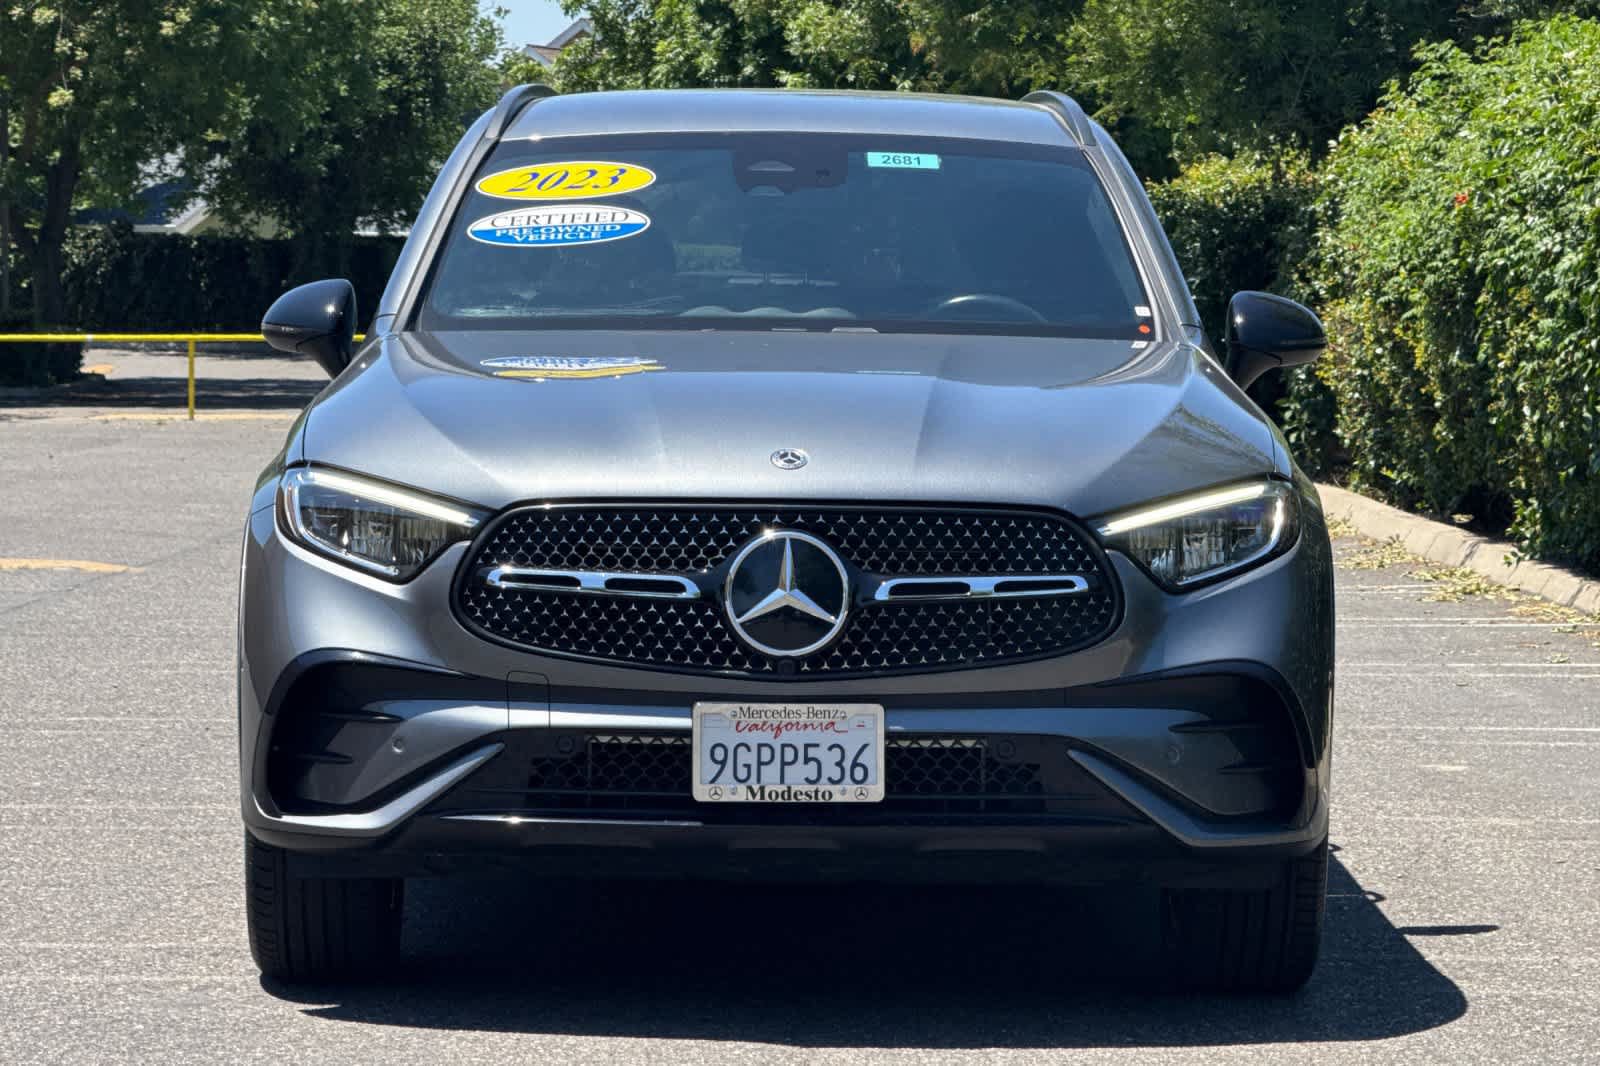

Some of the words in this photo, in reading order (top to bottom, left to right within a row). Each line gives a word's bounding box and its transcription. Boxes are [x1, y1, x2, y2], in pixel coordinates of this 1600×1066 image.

[881, 154, 921, 166] 2681
[504, 168, 627, 193] 2023
[490, 211, 629, 228] CERTIFIED
[495, 223, 621, 238] PRE-OWNED
[514, 231, 602, 243] VEHICLE
[738, 706, 840, 720] Mercedes-Benz
[735, 720, 848, 740] California
[709, 742, 870, 785] 9GPP536
[745, 785, 833, 801] Modesto
